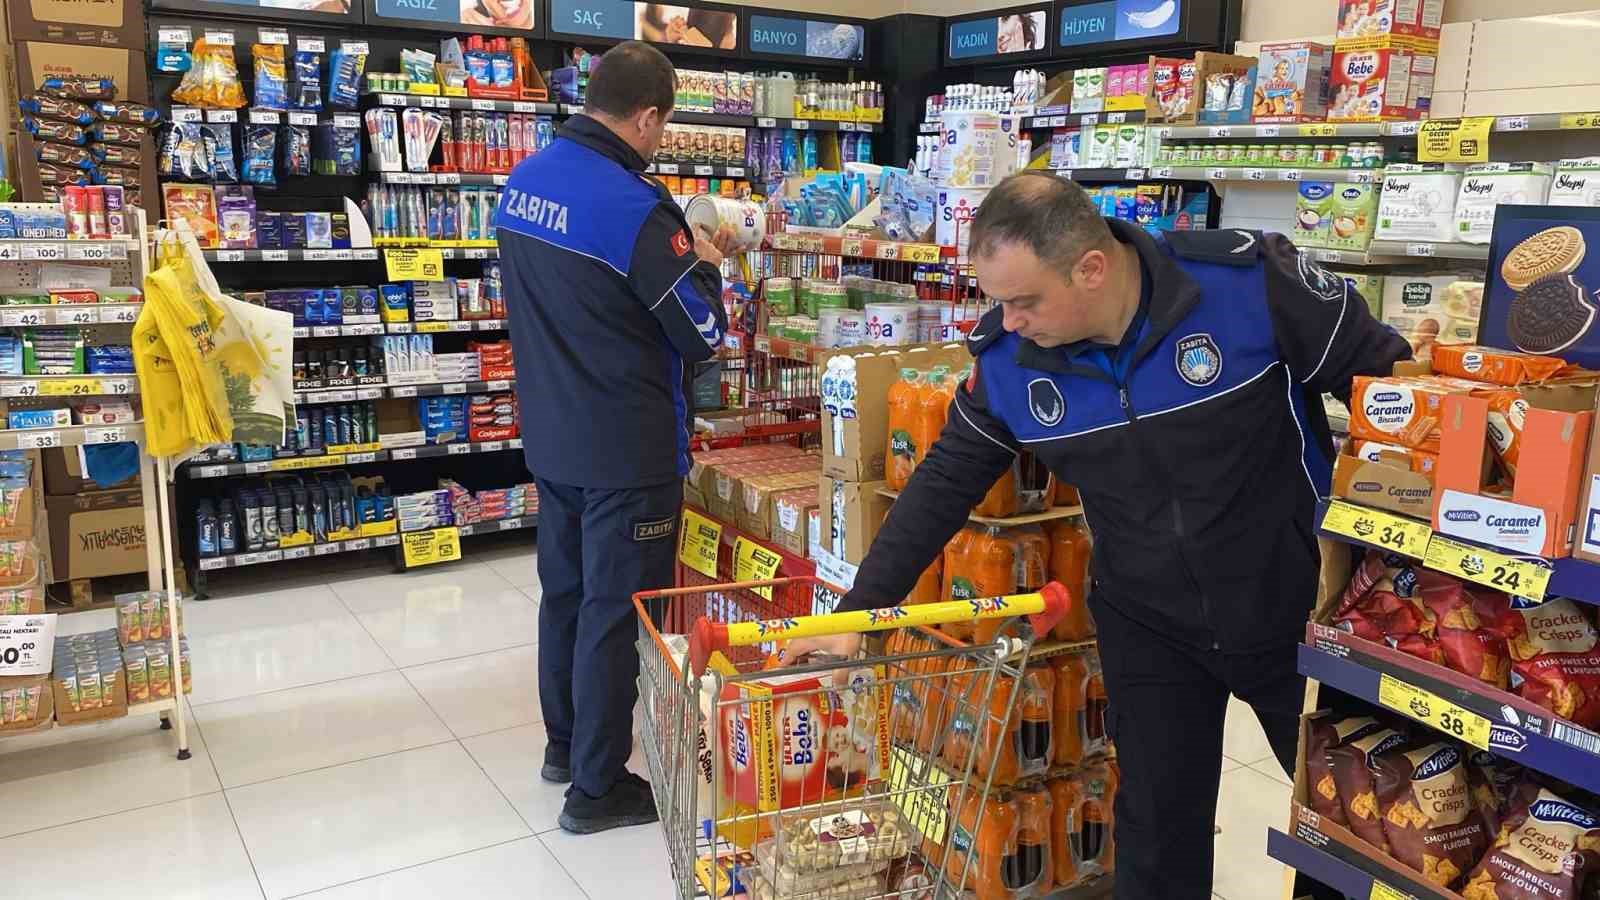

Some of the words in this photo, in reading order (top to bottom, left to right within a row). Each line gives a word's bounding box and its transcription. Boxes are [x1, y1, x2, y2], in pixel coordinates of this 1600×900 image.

[573, 10, 603, 30] SAÇ
[754, 29, 798, 46] BANYO
[957, 31, 988, 49] KADIN
[1347, 61, 1374, 75] Bebe
[505, 188, 569, 234] ZABITA
[36, 249, 57, 258] 100
[82, 249, 103, 258] 100
[885, 248, 894, 257] 59
[20, 315, 38, 325] 42
[73, 314, 89, 322] 42
[117, 312, 133, 321] 46
[298, 380, 321, 388] AXE
[330, 378, 353, 386] AXE
[360, 376, 383, 384] AXE
[20, 387, 36, 395] 47
[73, 385, 89, 394] 24
[113, 384, 126, 393] 19
[1366, 402, 1413, 416] Caramel
[1378, 416, 1404, 424] Biscuits
[103, 433, 118, 442] 35
[477, 428, 510, 439] Colgate
[36, 437, 53, 447] 33
[891, 438, 909, 450] fuse
[1388, 486, 1433, 497] Caramel
[1486, 514, 1541, 529] Caramel
[638, 520, 673, 537] ZABITA
[1378, 525, 1404, 548] 34
[1490, 566, 1520, 591] 24
[1530, 613, 1584, 629] Cracker
[1538, 629, 1583, 642] Crisps
[1439, 712, 1465, 737] 38
[1414, 749, 1457, 779] McVitie's
[1432, 799, 1465, 814] Crisps
[1535, 802, 1595, 825] McVitie's
[1524, 825, 1570, 850] Cracker
[1519, 837, 1560, 862] Crisps
[1501, 871, 1540, 894] FLAVOUR
